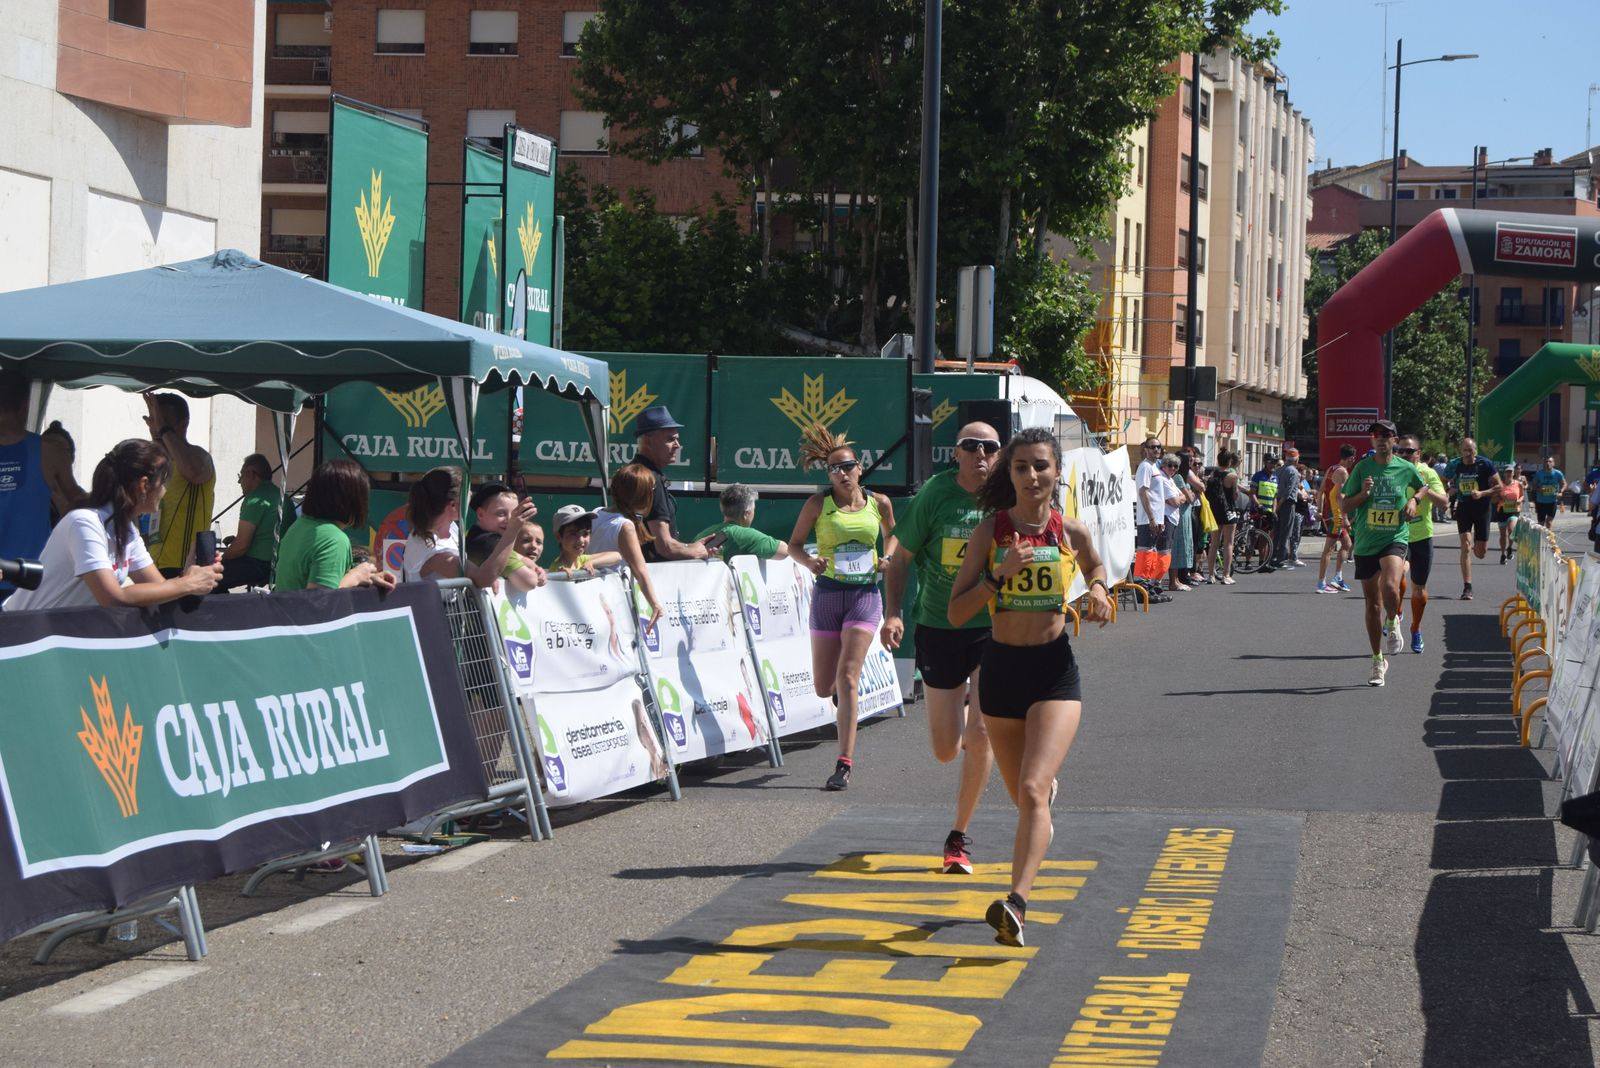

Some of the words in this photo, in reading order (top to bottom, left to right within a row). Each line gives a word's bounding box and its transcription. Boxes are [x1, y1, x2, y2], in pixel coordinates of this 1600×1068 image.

[1515, 237, 1559, 247] DIPUTACIÓN
[1514, 245, 1571, 259] ZAMORA
[1336, 424, 1371, 432] ZAMOR
[341, 434, 399, 457] CAJA
[536, 440, 595, 462] CAJA
[607, 443, 690, 466] RUL
[735, 448, 796, 470] CAJA
[1371, 511, 1395, 524] 147
[848, 561, 861, 573] ANA
[1013, 599, 1032, 607] CAJA
[1034, 598, 1057, 606] RURAL
[155, 700, 266, 798] CAJA
[255, 681, 390, 779] RURAL
[571, 744, 592, 759] osea
[1143, 827, 1235, 893] INTERIORES
[1115, 897, 1214, 950] DISEÑO
[547, 854, 1098, 1068] IDEPAR
